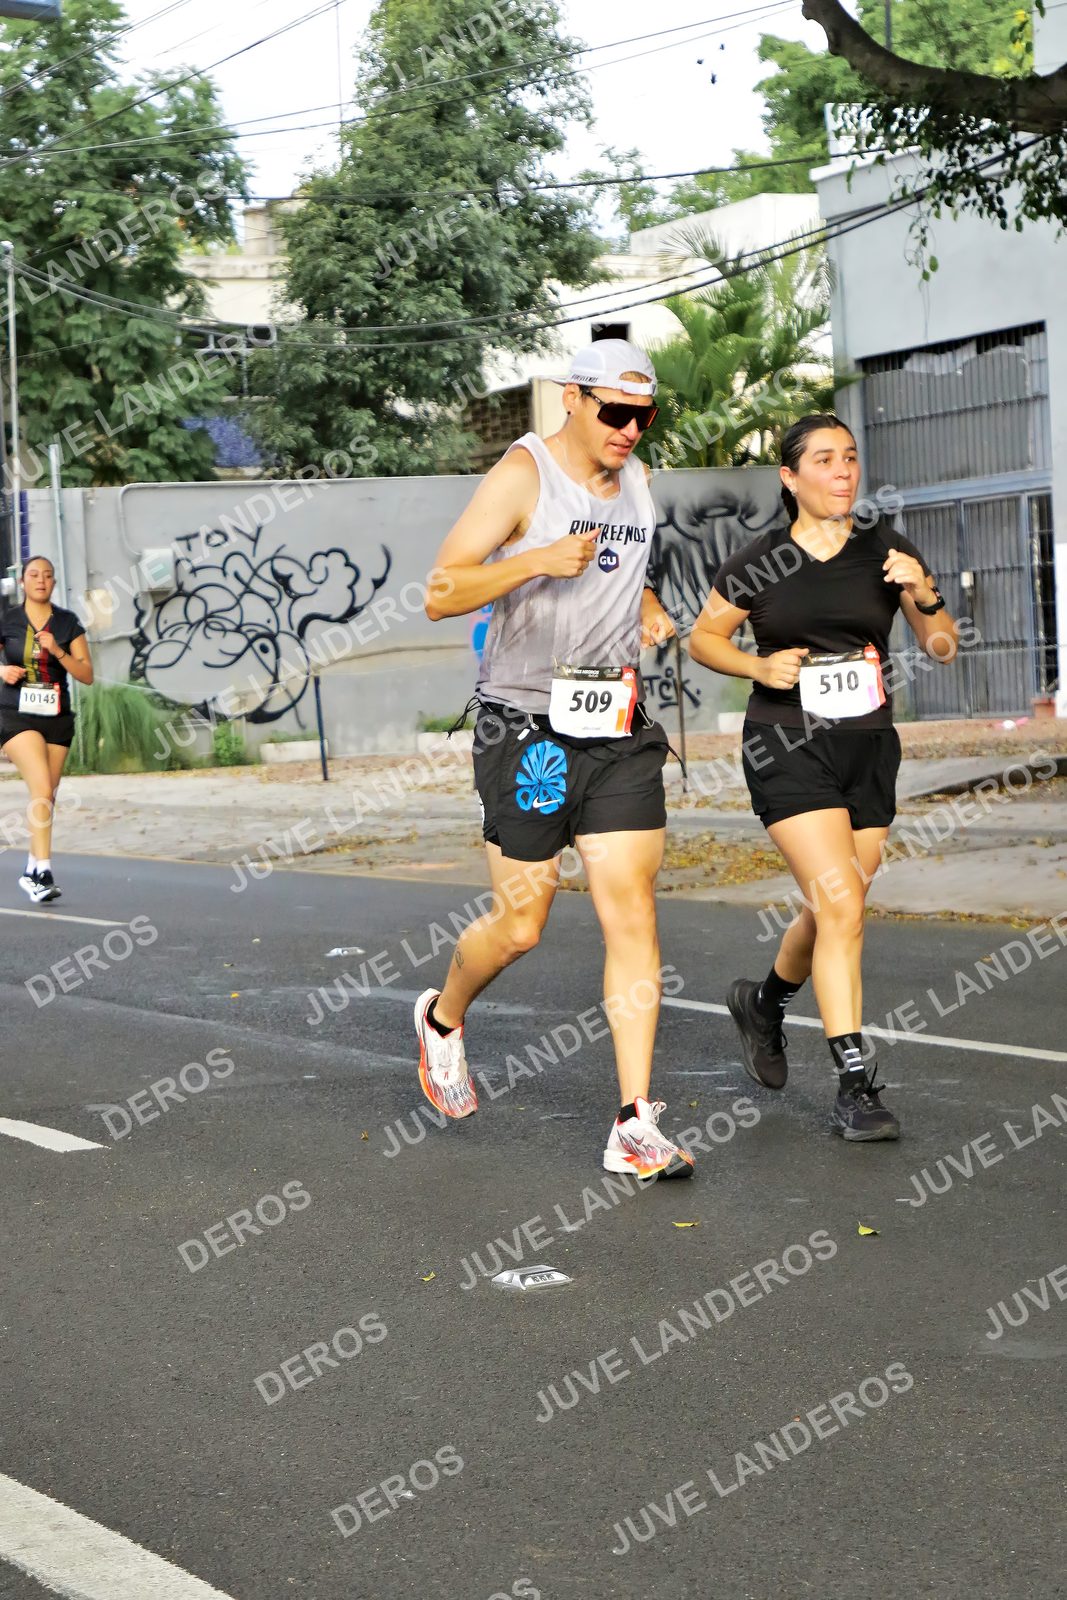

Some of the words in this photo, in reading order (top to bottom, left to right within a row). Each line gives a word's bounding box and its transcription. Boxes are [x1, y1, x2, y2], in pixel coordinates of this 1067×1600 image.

[175, 523, 263, 557] TOY
[599, 556, 617, 565] GU
[820, 669, 859, 695] 510
[24, 692, 56, 704] 10145
[569, 690, 613, 713] 509
